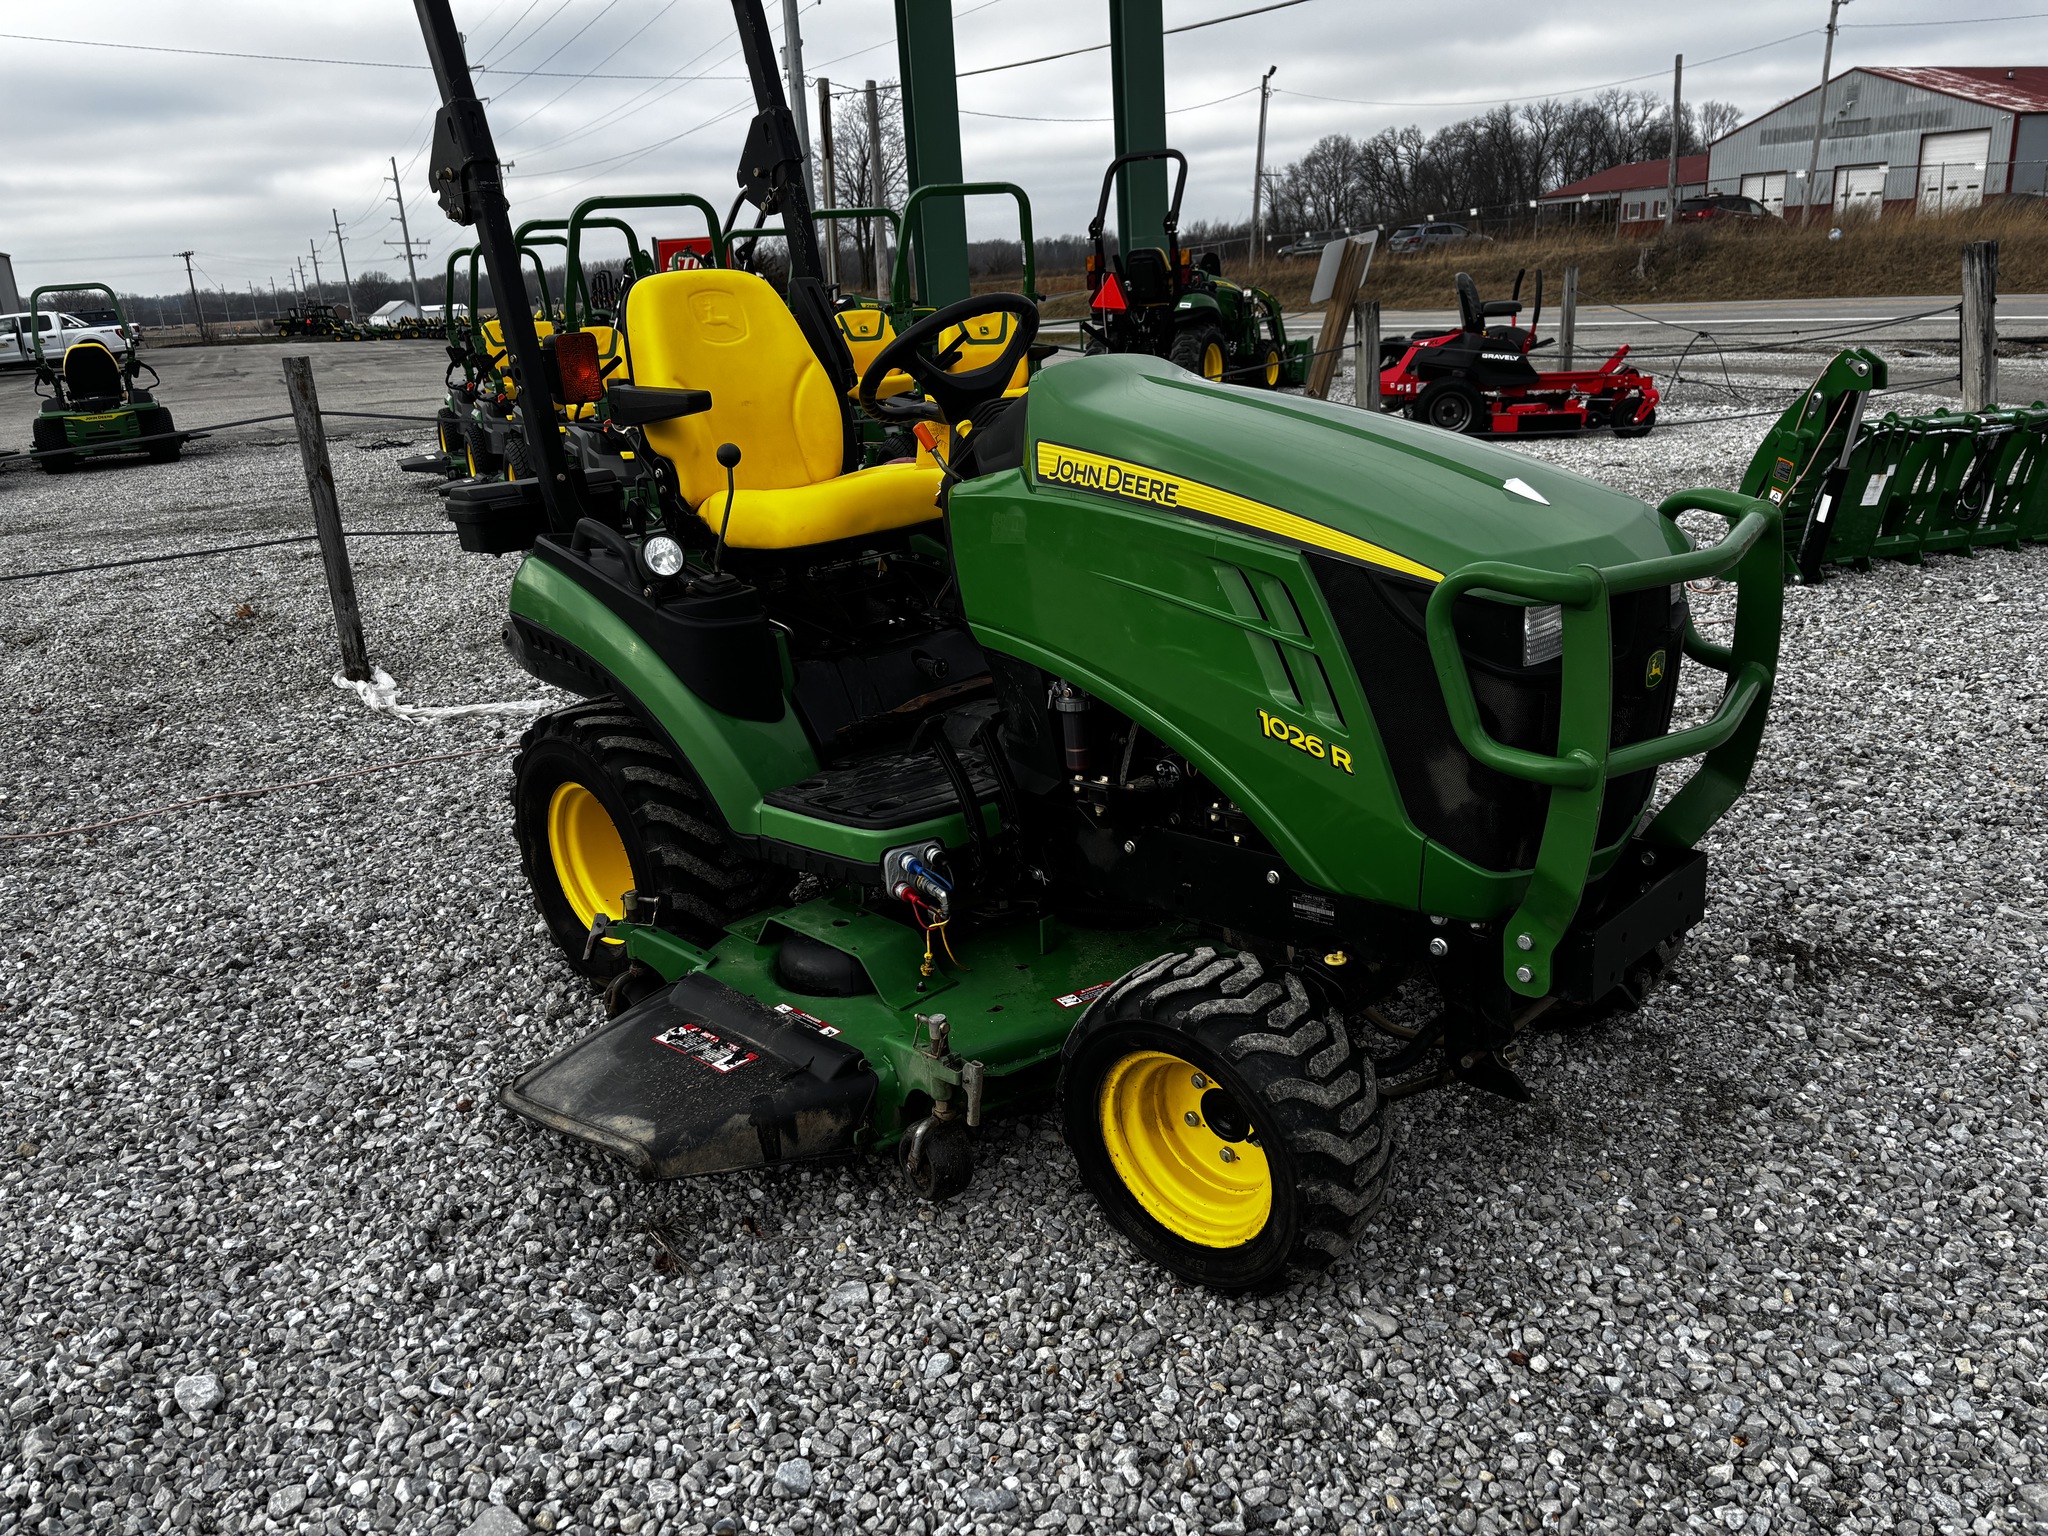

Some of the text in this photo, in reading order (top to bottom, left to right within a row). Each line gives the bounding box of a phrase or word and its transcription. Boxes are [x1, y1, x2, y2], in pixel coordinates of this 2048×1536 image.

[1481, 353, 1519, 361] GRAVELY
[1049, 455, 1179, 505] JOHN DEERE
[1256, 708, 1355, 776] 1026 R
